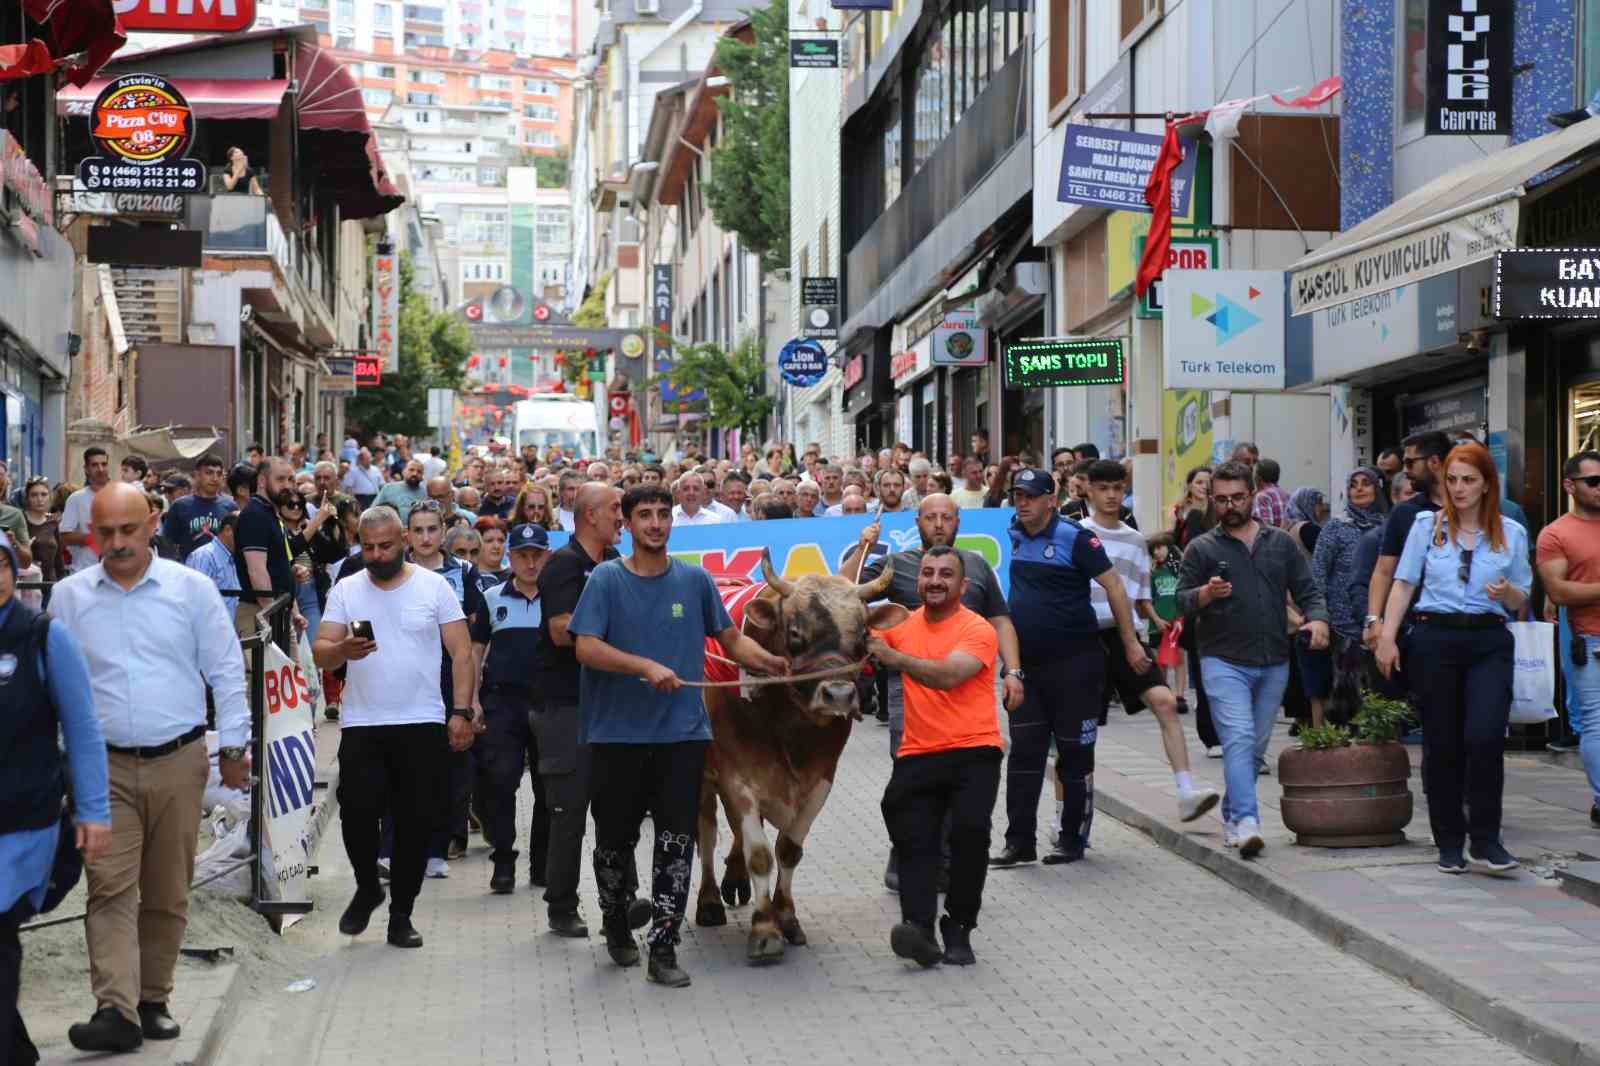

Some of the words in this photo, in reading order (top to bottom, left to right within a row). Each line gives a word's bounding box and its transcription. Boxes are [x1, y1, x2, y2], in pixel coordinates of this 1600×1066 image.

[1448, 0, 1490, 99] YLE
[118, 76, 165, 89] Artvin'in
[106, 114, 146, 128] Pizza
[147, 111, 178, 128] City
[131, 129, 155, 144] 08
[1092, 153, 1118, 167] MALİ
[102, 168, 111, 177] 0
[112, 167, 142, 179] (466)
[143, 168, 164, 178] 212
[165, 168, 180, 178] 21
[181, 168, 197, 178] 40
[102, 178, 111, 187] 0
[112, 177, 142, 189] (539)
[143, 178, 164, 188] 612
[165, 178, 180, 188] 21
[181, 178, 197, 188] 40
[1068, 184, 1090, 197] TEL
[1169, 248, 1208, 269] POR
[1354, 232, 1452, 290] KUYUMCULUK
[1064, 353, 1110, 370] TOPU
[1180, 360, 1212, 373] Türk
[1215, 360, 1277, 375] Telekom
